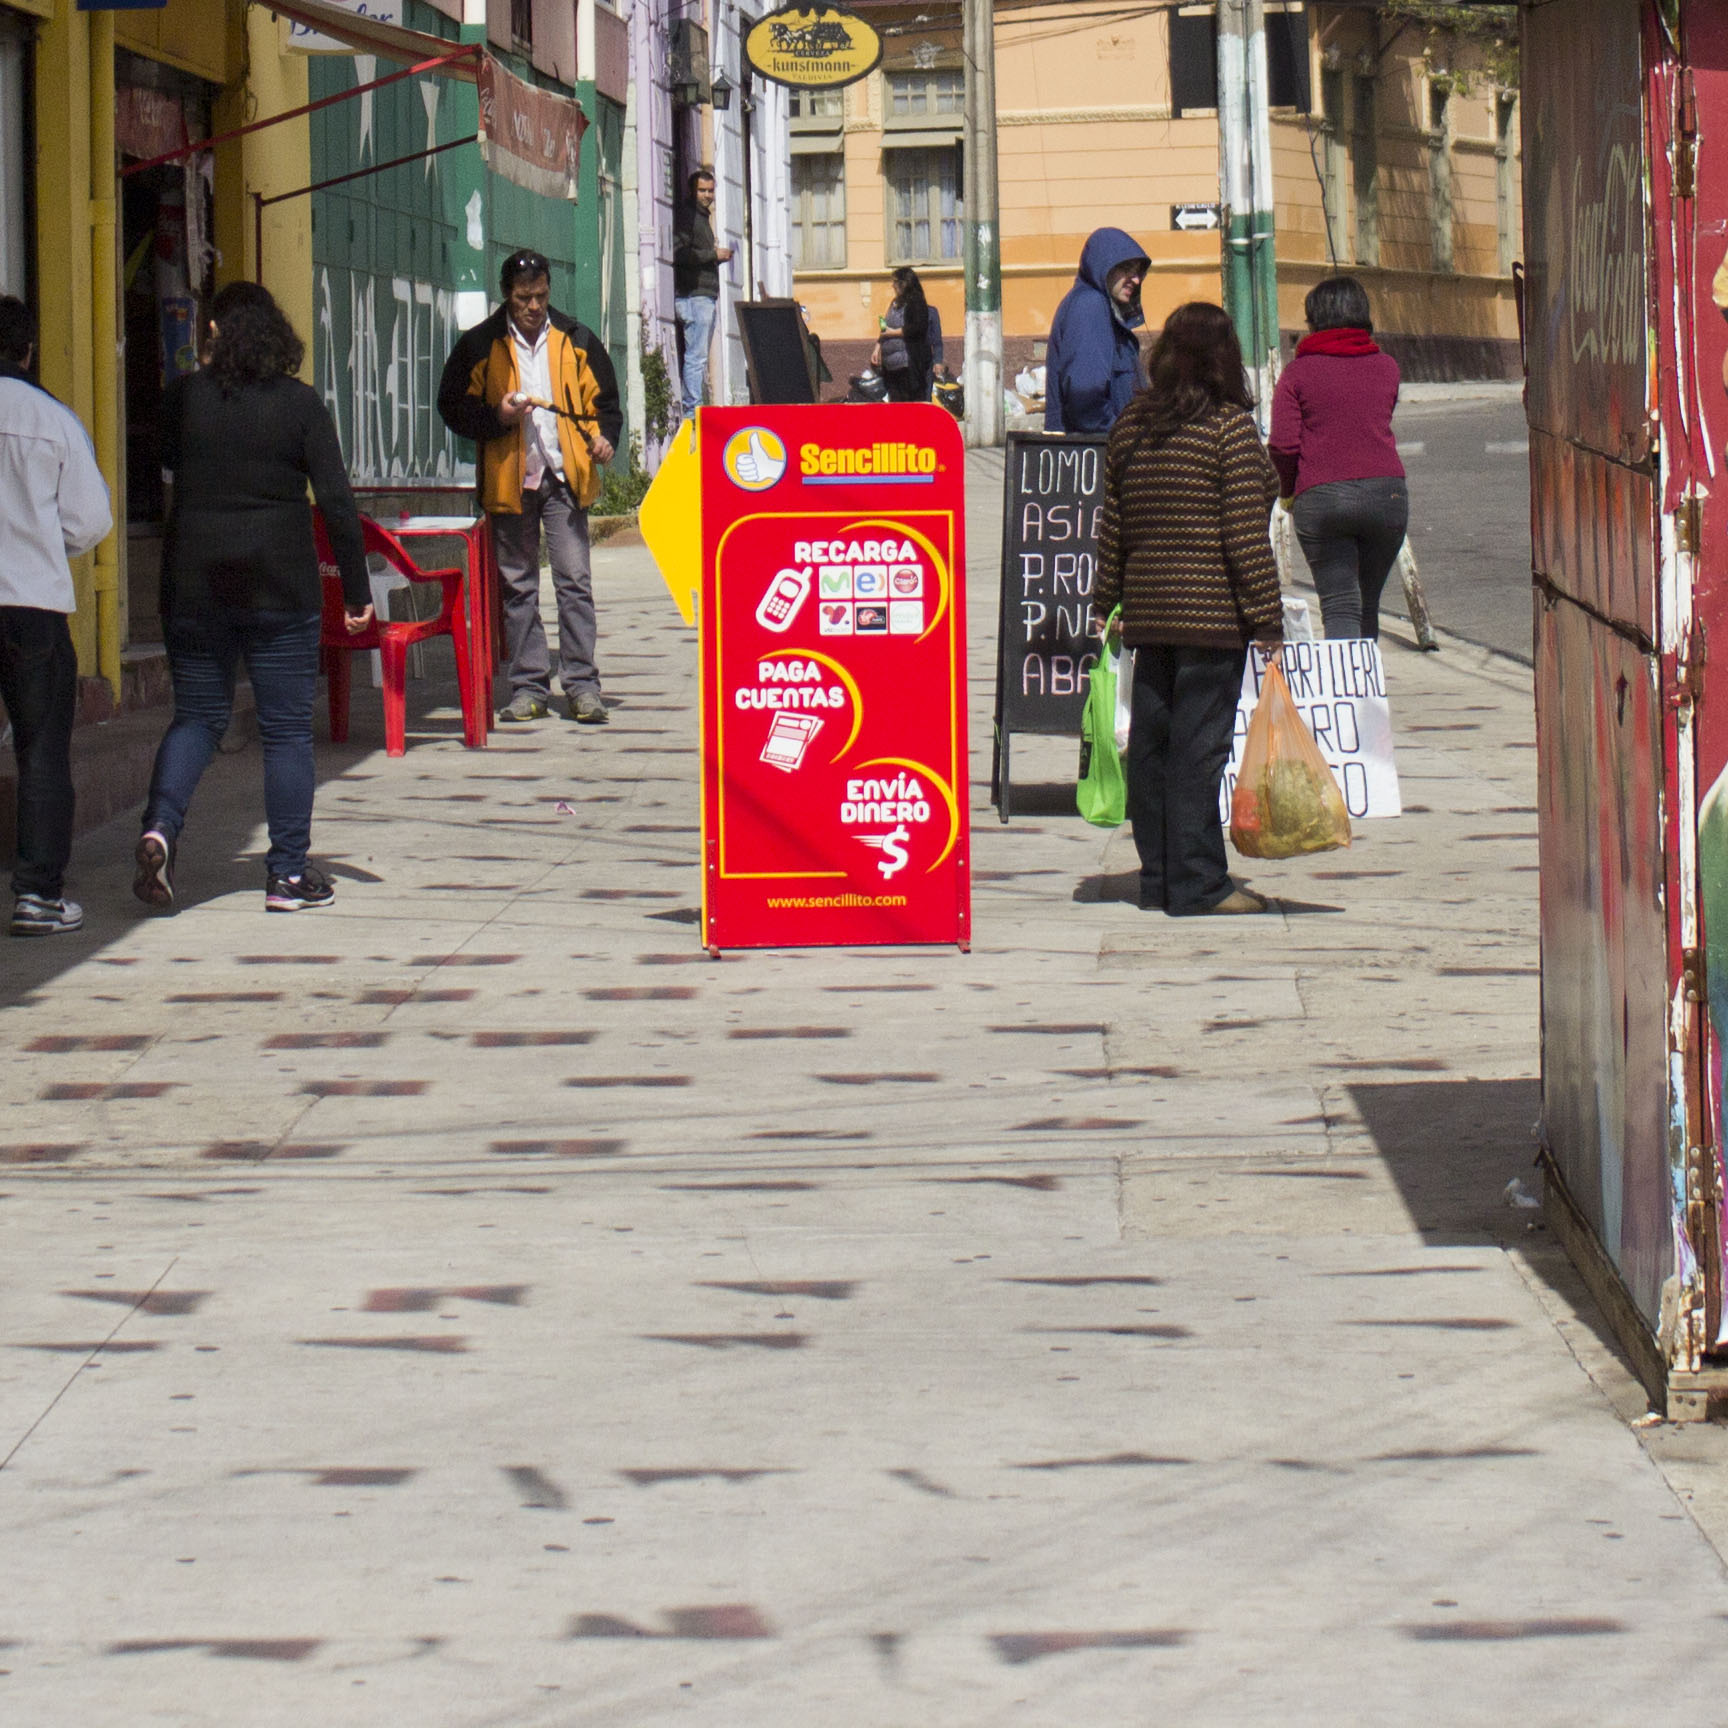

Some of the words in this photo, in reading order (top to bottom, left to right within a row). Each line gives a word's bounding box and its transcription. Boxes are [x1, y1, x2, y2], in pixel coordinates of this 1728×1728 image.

[772, 57, 851, 73] kunstmann
[799, 442, 937, 475] Sencillito
[1021, 447, 1098, 496] LOMO
[793, 539, 918, 564] RECARGA
[758, 660, 822, 684] PAGA
[734, 685, 846, 710] CUENTAS
[840, 800, 931, 824] DINERO
[766, 892, 908, 910] www.sencillito.com
